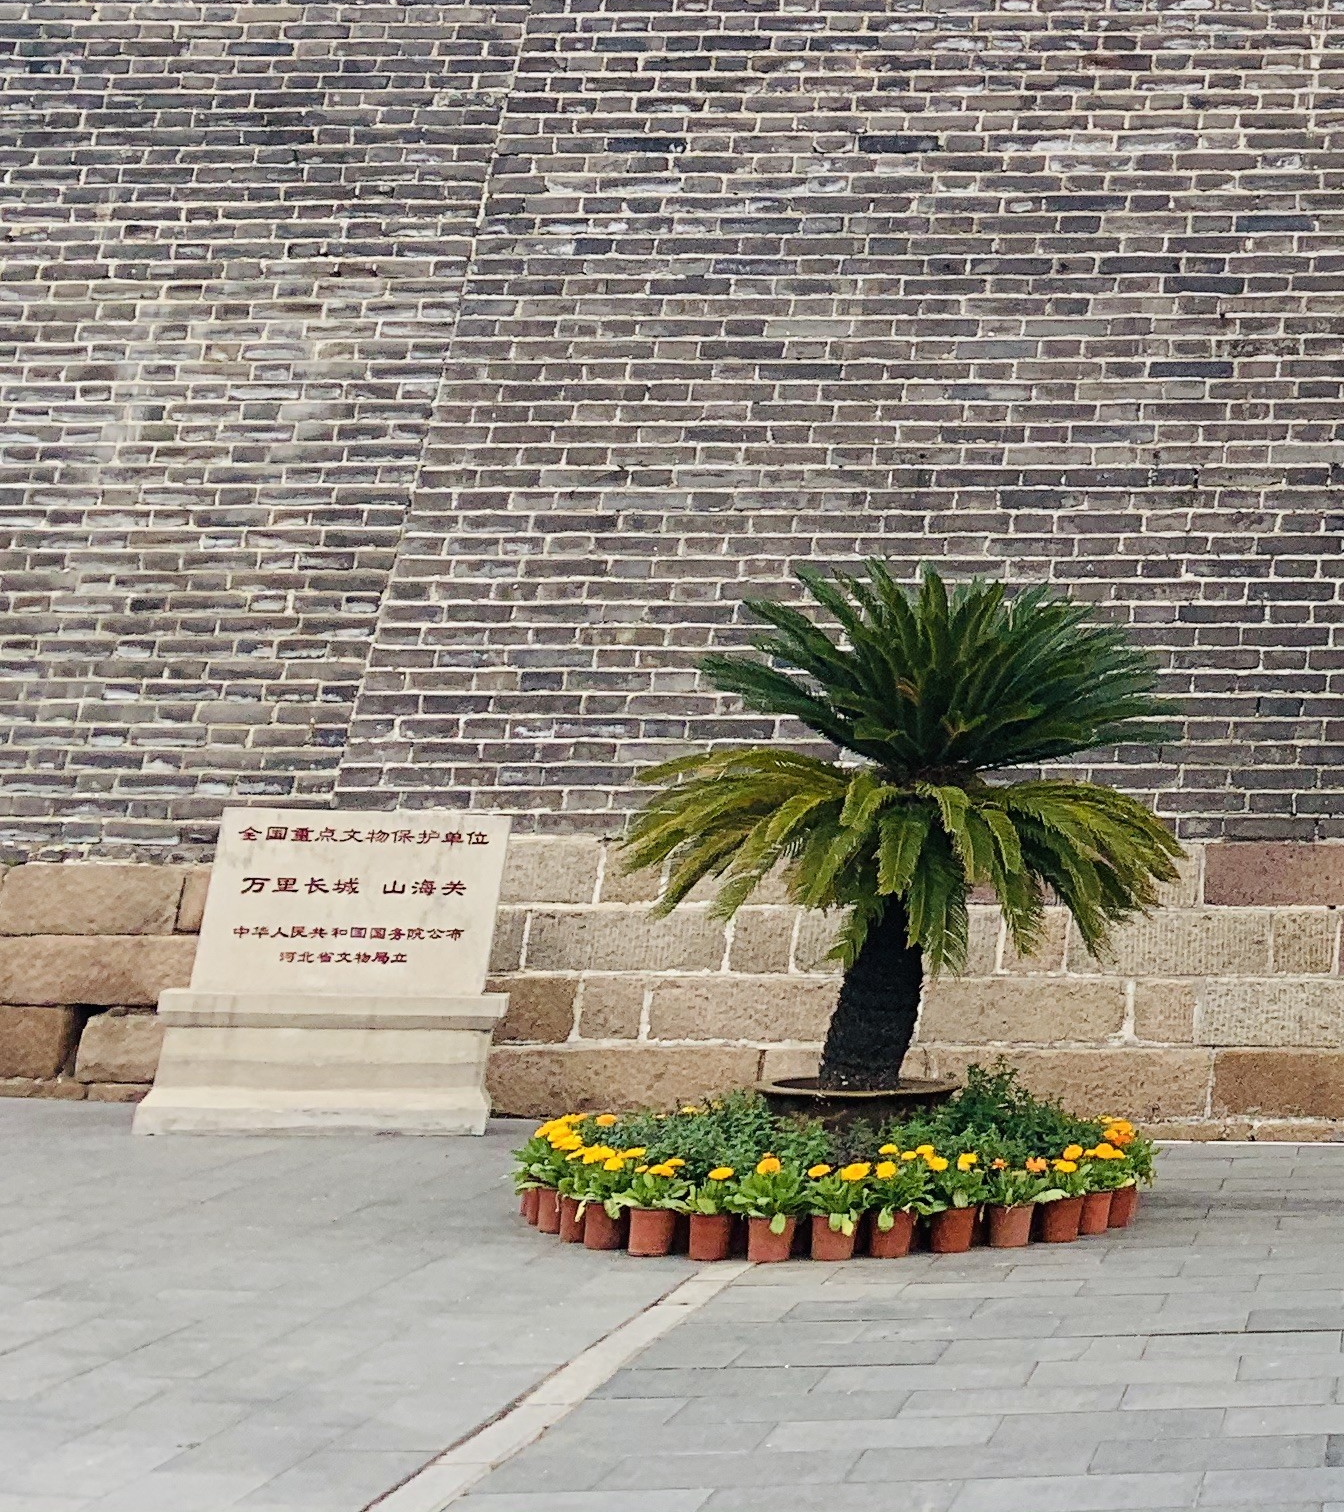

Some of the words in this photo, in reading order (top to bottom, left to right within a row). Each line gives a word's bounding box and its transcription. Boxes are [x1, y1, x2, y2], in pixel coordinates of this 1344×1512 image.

[238, 826, 489, 846] 全国重点文物保护单位
[241, 876, 360, 895] 万里长城
[383, 879, 467, 896] 山海关
[233, 926, 464, 941] 中华人民共和国国务院公布
[279, 951, 407, 964] 河北省文物局立
